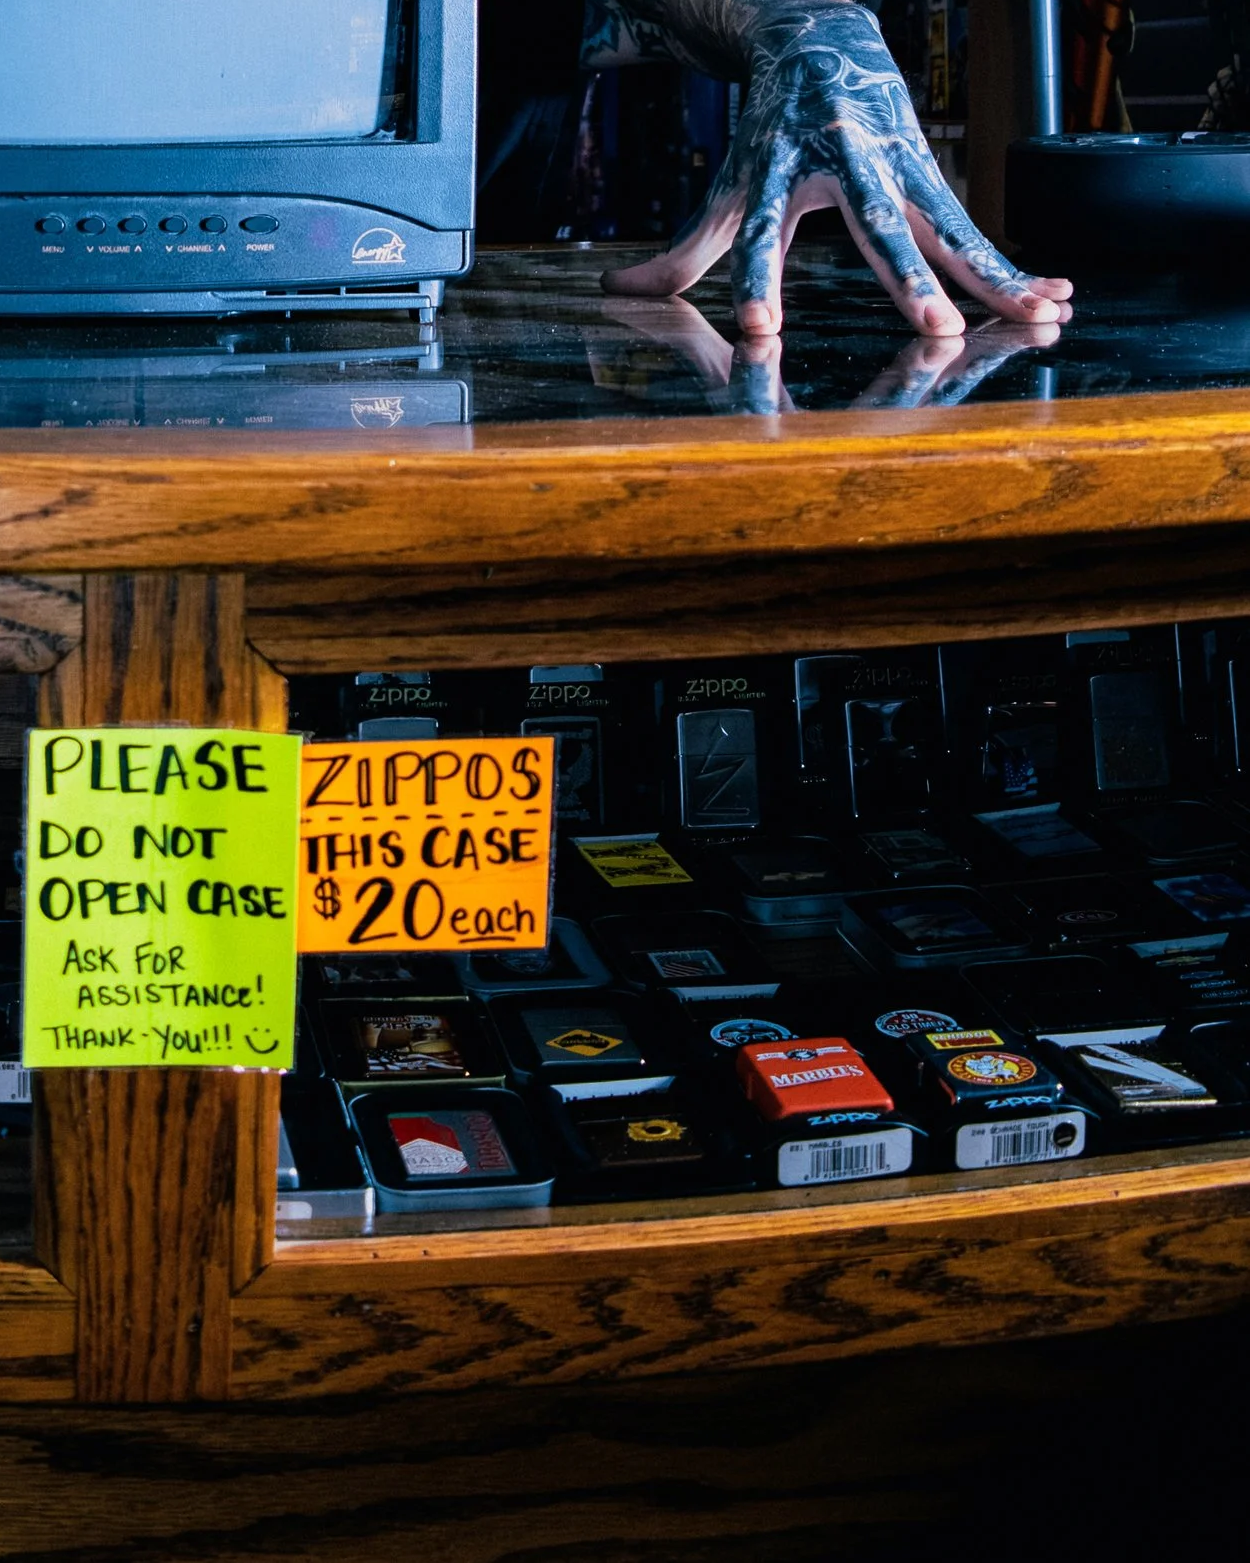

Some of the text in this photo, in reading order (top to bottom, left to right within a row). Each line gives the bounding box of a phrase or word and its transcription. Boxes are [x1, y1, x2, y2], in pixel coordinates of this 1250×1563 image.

[41, 245, 65, 253] MENU
[98, 245, 131, 253] VOLUME
[177, 244, 213, 253] CHANNEL
[246, 243, 275, 253] POWER
[369, 686, 432, 707] zippo
[529, 683, 591, 704] zippo
[686, 677, 748, 697] zippo
[44, 735, 268, 795] PLEASE
[306, 747, 541, 808] ZIPPOS
[39, 820, 227, 860] DO NOT
[301, 827, 538, 874] THIS CASE
[39, 876, 287, 921] OPEN CASE
[450, 899, 535, 936] each
[62, 939, 185, 975] ASK FOR
[886, 1020, 946, 1031] OLD TIMER
[770, 1065, 865, 1089] MARBLE'S
[985, 1096, 1051, 1110] zippo
[807, 1111, 880, 1126] zippo
